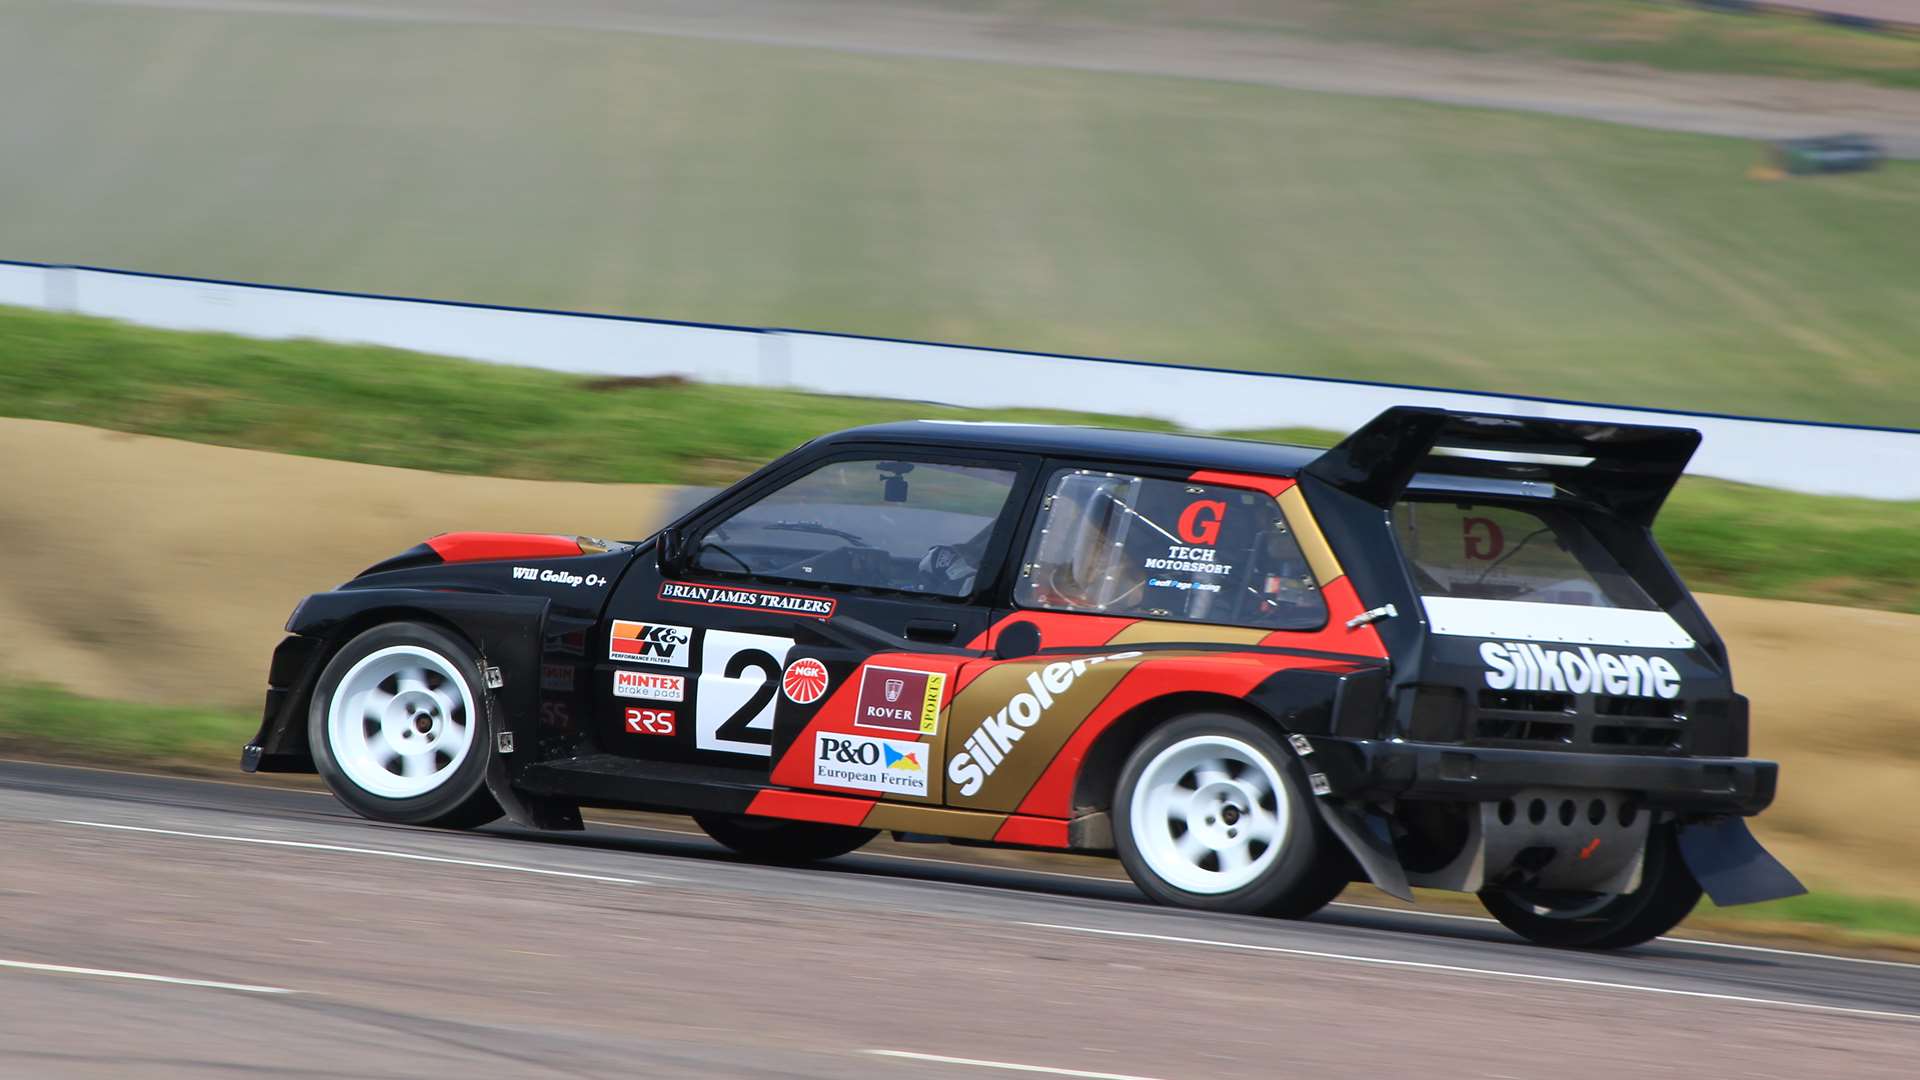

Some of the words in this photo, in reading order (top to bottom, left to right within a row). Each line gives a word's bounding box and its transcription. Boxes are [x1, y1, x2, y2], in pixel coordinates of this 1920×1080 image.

[1176, 499, 1227, 546] G
[1168, 546, 1216, 562] TECH
[512, 567, 539, 581] Will
[540, 570, 582, 587] Gollop
[585, 574, 607, 587] O+
[1145, 558, 1232, 575] MOTORSPORT
[662, 584, 709, 600] BRIAN
[708, 589, 757, 605] JAMES
[759, 594, 832, 613] TRAILERS
[611, 653, 649, 662] PERFORMANCE
[649, 656, 671, 664] FILTERS
[794, 666, 820, 678] NGK
[1479, 642, 1681, 699] Silkolene
[618, 673, 680, 690] MINTEX
[618, 685, 649, 696] brake
[654, 689, 681, 699] pads
[715, 648, 782, 745] 2
[922, 676, 941, 730] SPORTS
[627, 709, 673, 734] RRS
[867, 705, 913, 721] ROVER
[819, 737, 880, 765] P&O
[817, 765, 877, 783] European
[881, 772, 924, 788] Ferries
